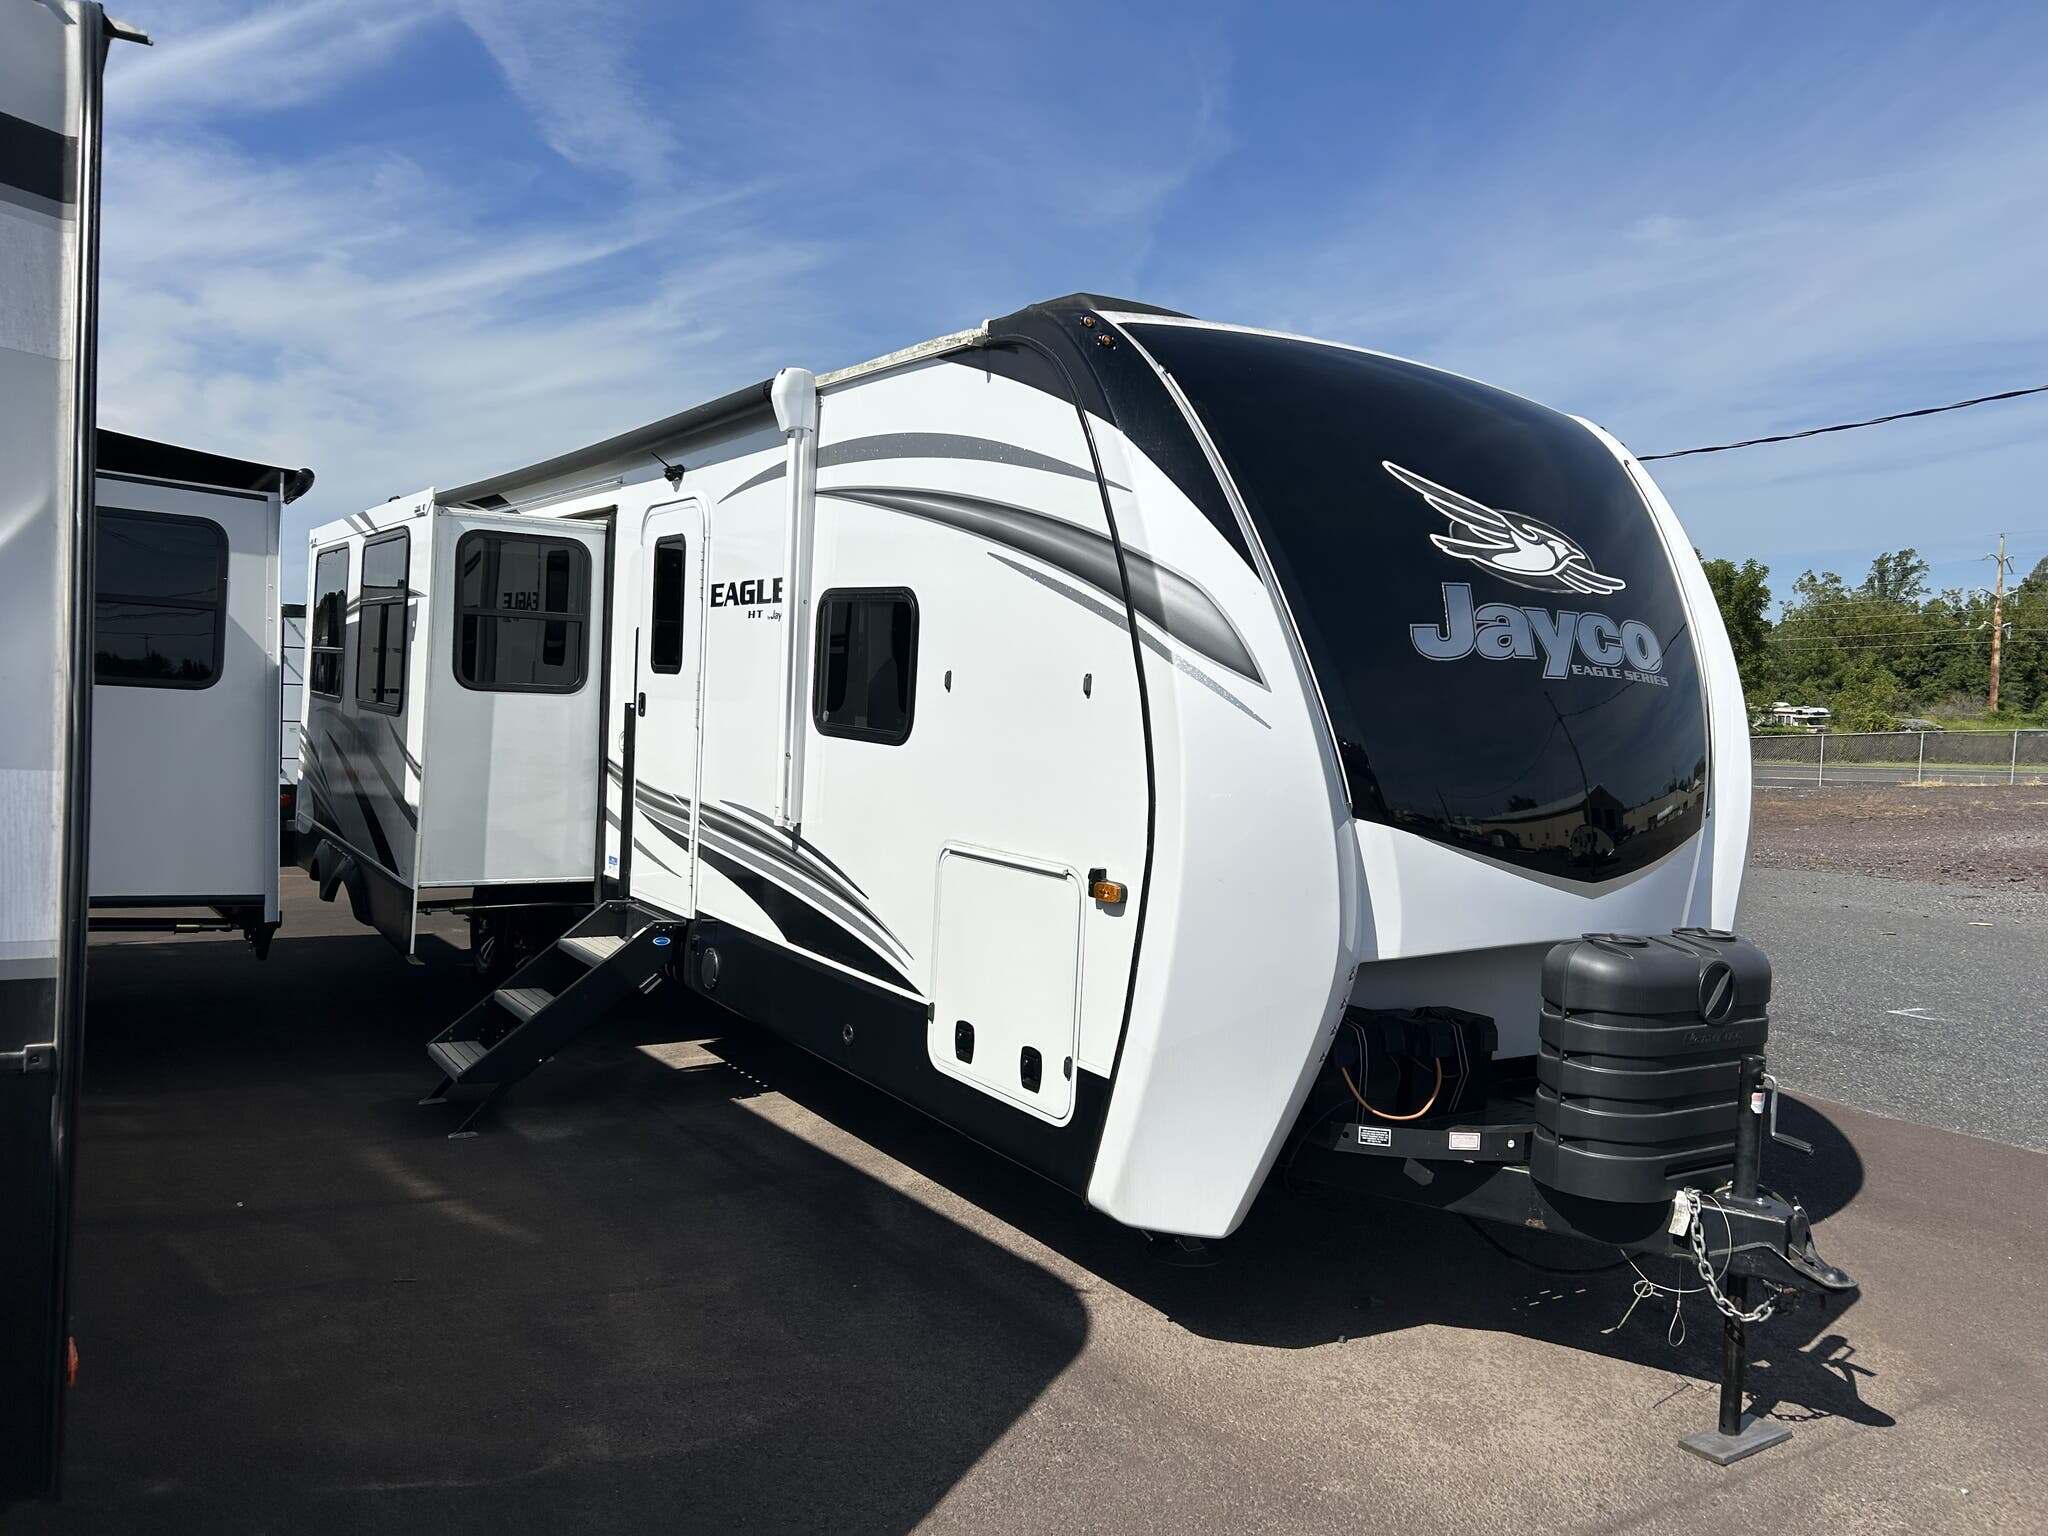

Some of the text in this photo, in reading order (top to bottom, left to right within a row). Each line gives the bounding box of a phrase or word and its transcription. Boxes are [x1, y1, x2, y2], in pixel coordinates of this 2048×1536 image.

[710, 577, 783, 607] EAGLE
[747, 609, 764, 619] HT
[1409, 581, 1664, 680] Jayco
[1571, 664, 1670, 687] EAGLE SERIES
